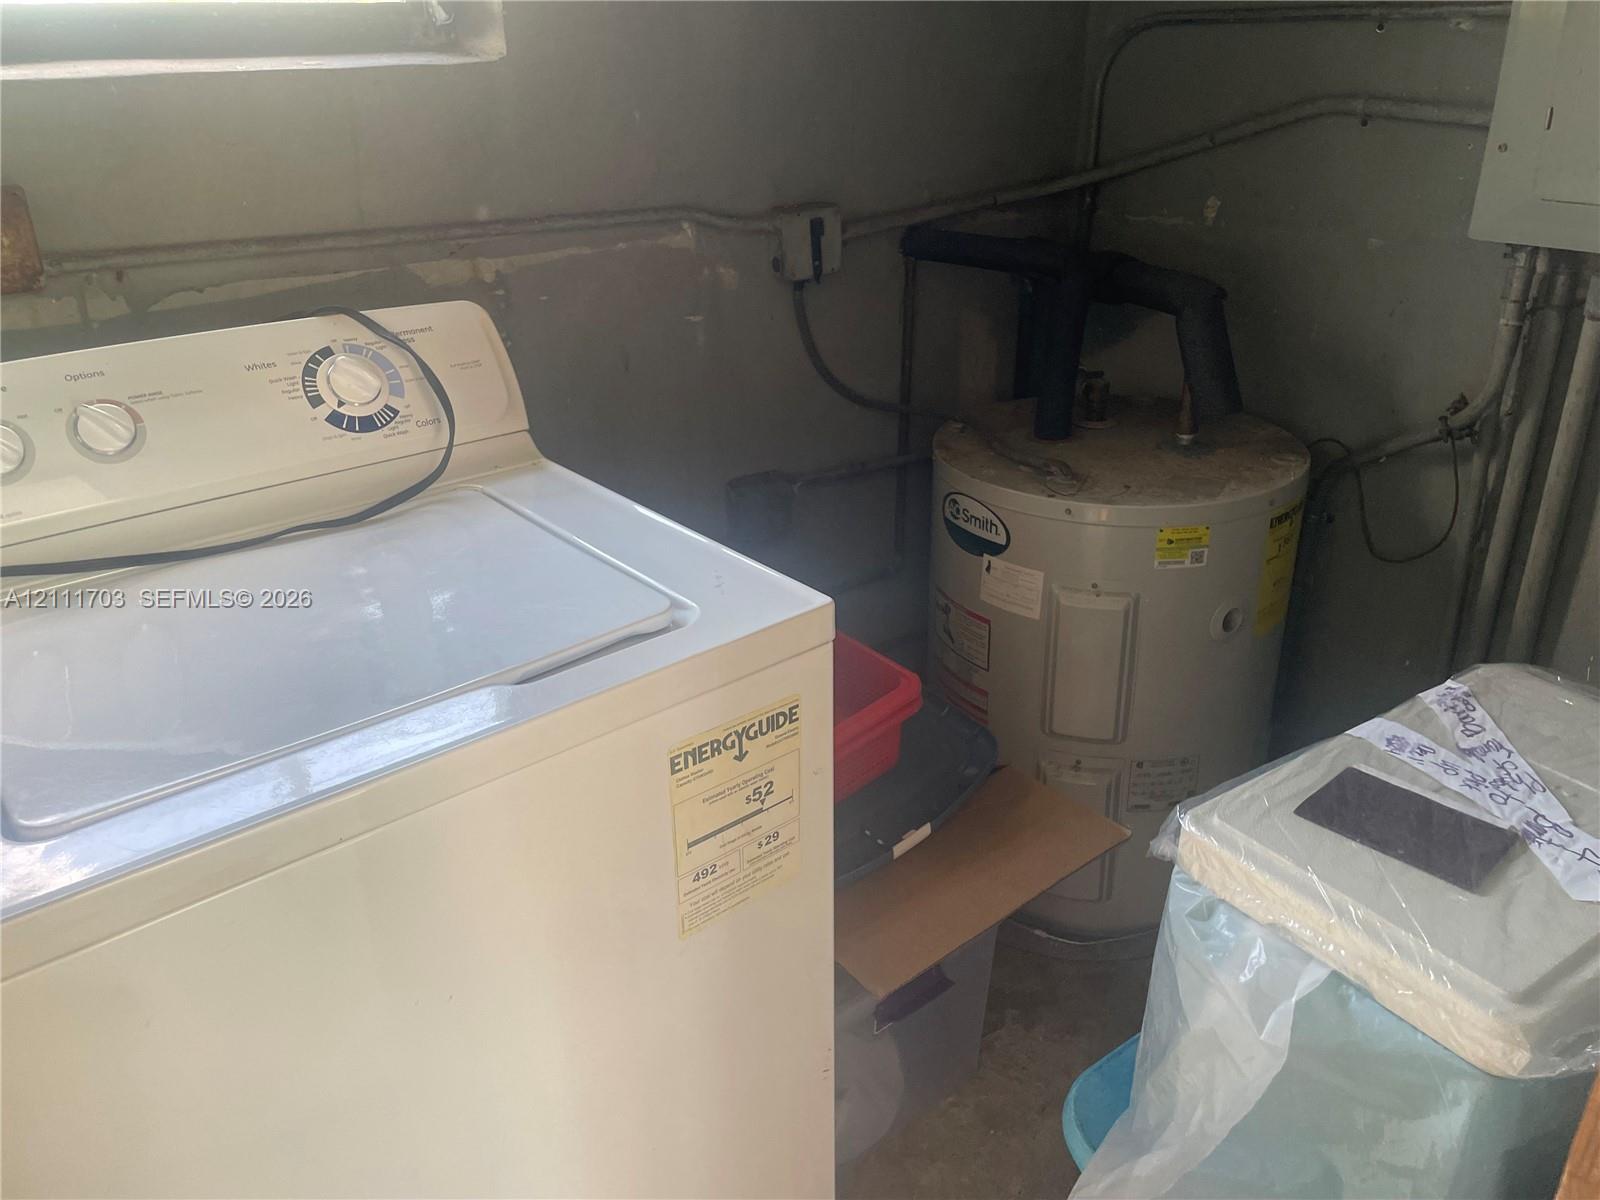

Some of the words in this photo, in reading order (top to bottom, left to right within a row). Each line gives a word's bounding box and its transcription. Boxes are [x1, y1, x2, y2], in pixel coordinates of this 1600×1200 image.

[391, 326, 433, 338] ermanent
[244, 359, 278, 372] Whites
[64, 369, 105, 383] Options
[415, 416, 441, 428] Colors
[670, 704, 800, 776] ENERGYGUIDE
[745, 780, 775, 805] $52
[692, 863, 719, 883] 492
